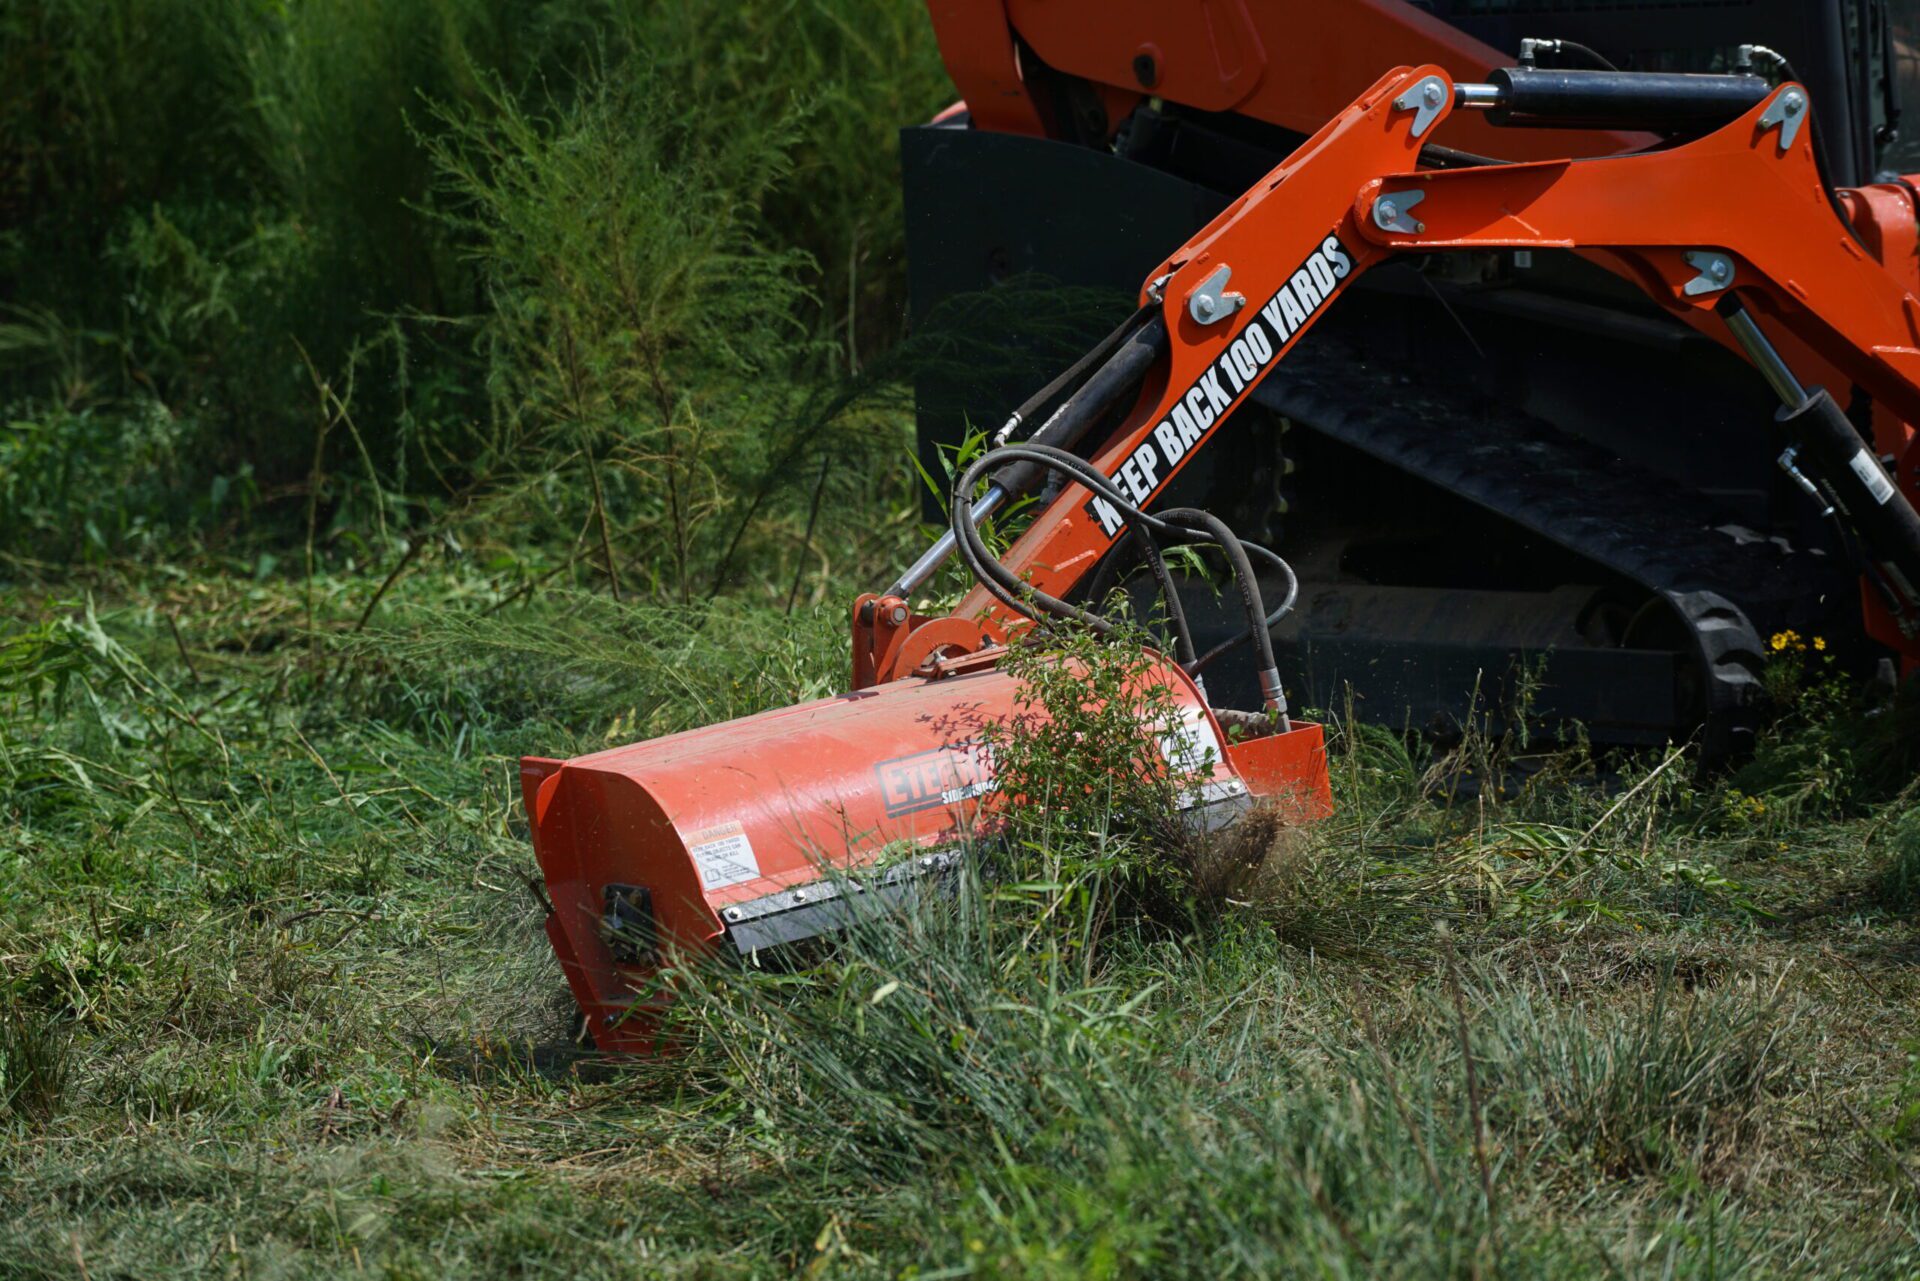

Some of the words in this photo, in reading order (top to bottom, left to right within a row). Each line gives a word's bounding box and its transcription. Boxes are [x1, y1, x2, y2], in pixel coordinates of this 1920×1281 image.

[1092, 443, 1158, 536] KEEP
[1155, 366, 1232, 467] BACK
[1219, 323, 1272, 393] 100
[1262, 236, 1351, 344] YARDS
[702, 824, 737, 839] DANGER
